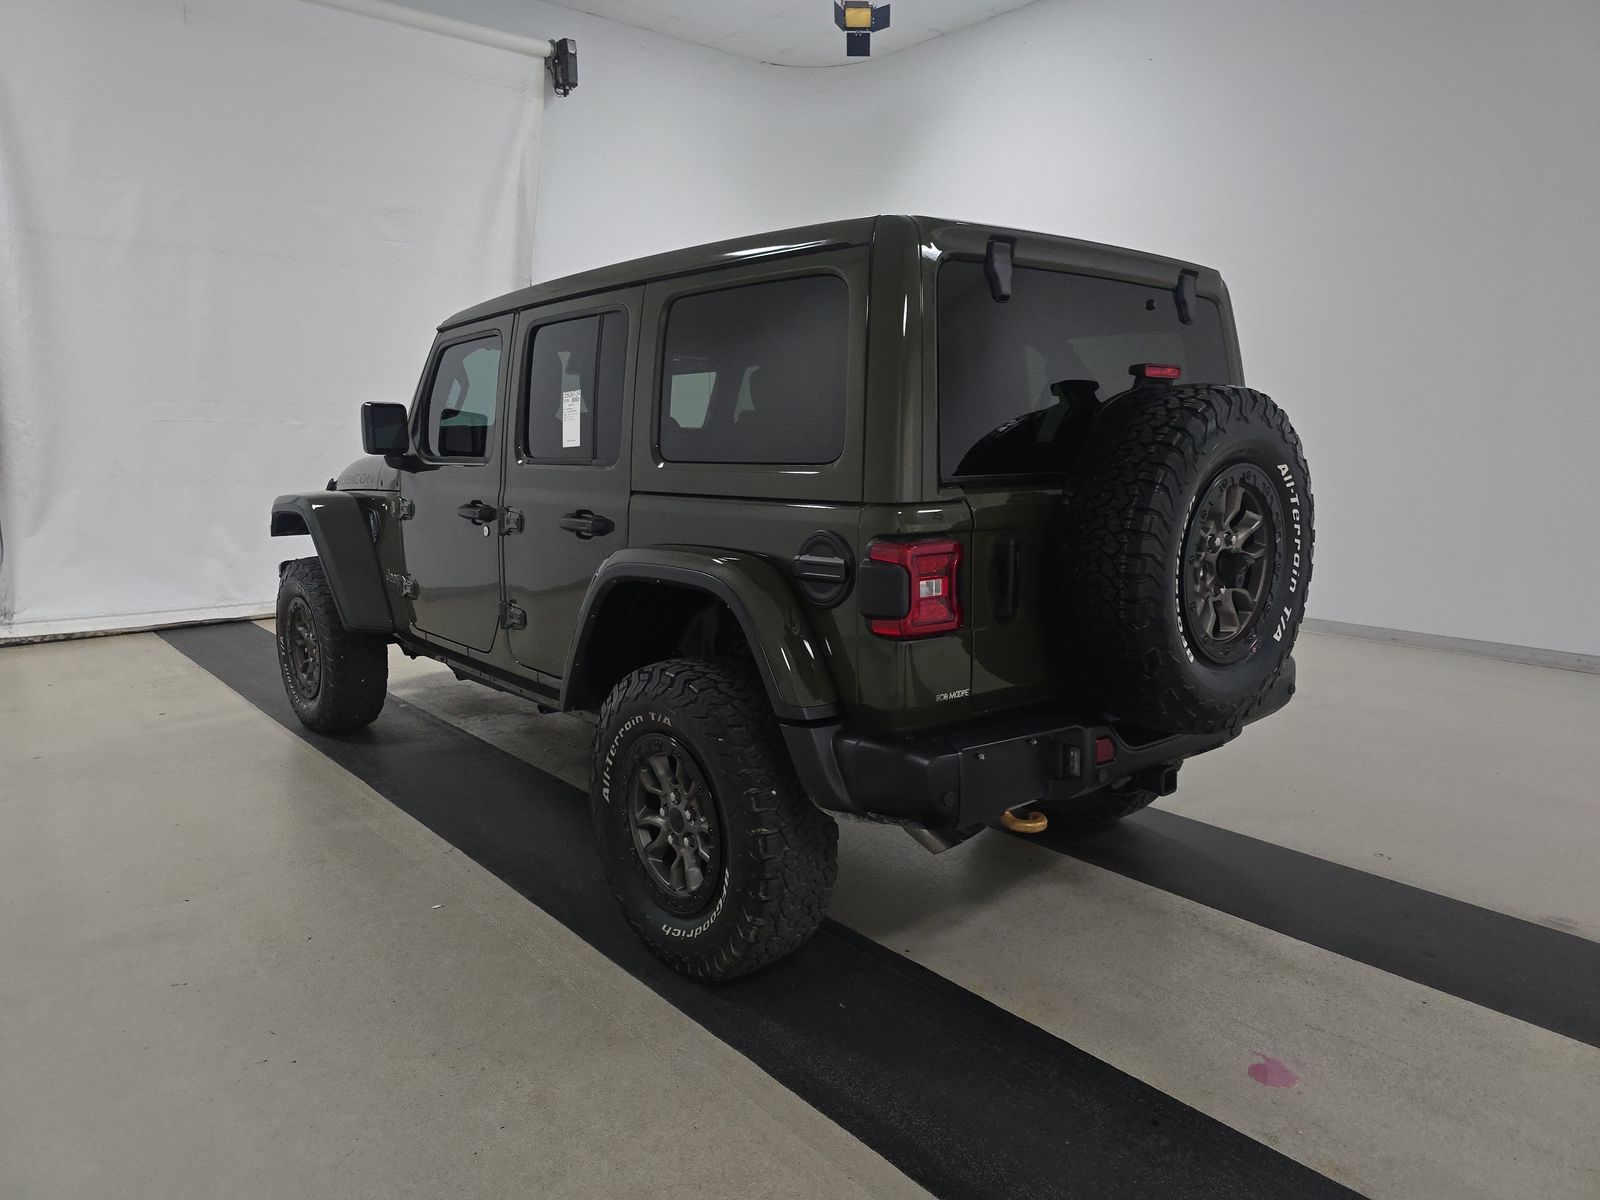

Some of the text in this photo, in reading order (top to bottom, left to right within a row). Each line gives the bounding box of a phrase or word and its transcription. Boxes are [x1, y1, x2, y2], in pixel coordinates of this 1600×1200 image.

[1272, 463, 1300, 642] All-Terrain T/A
[602, 711, 672, 803] All-Terrain T/A
